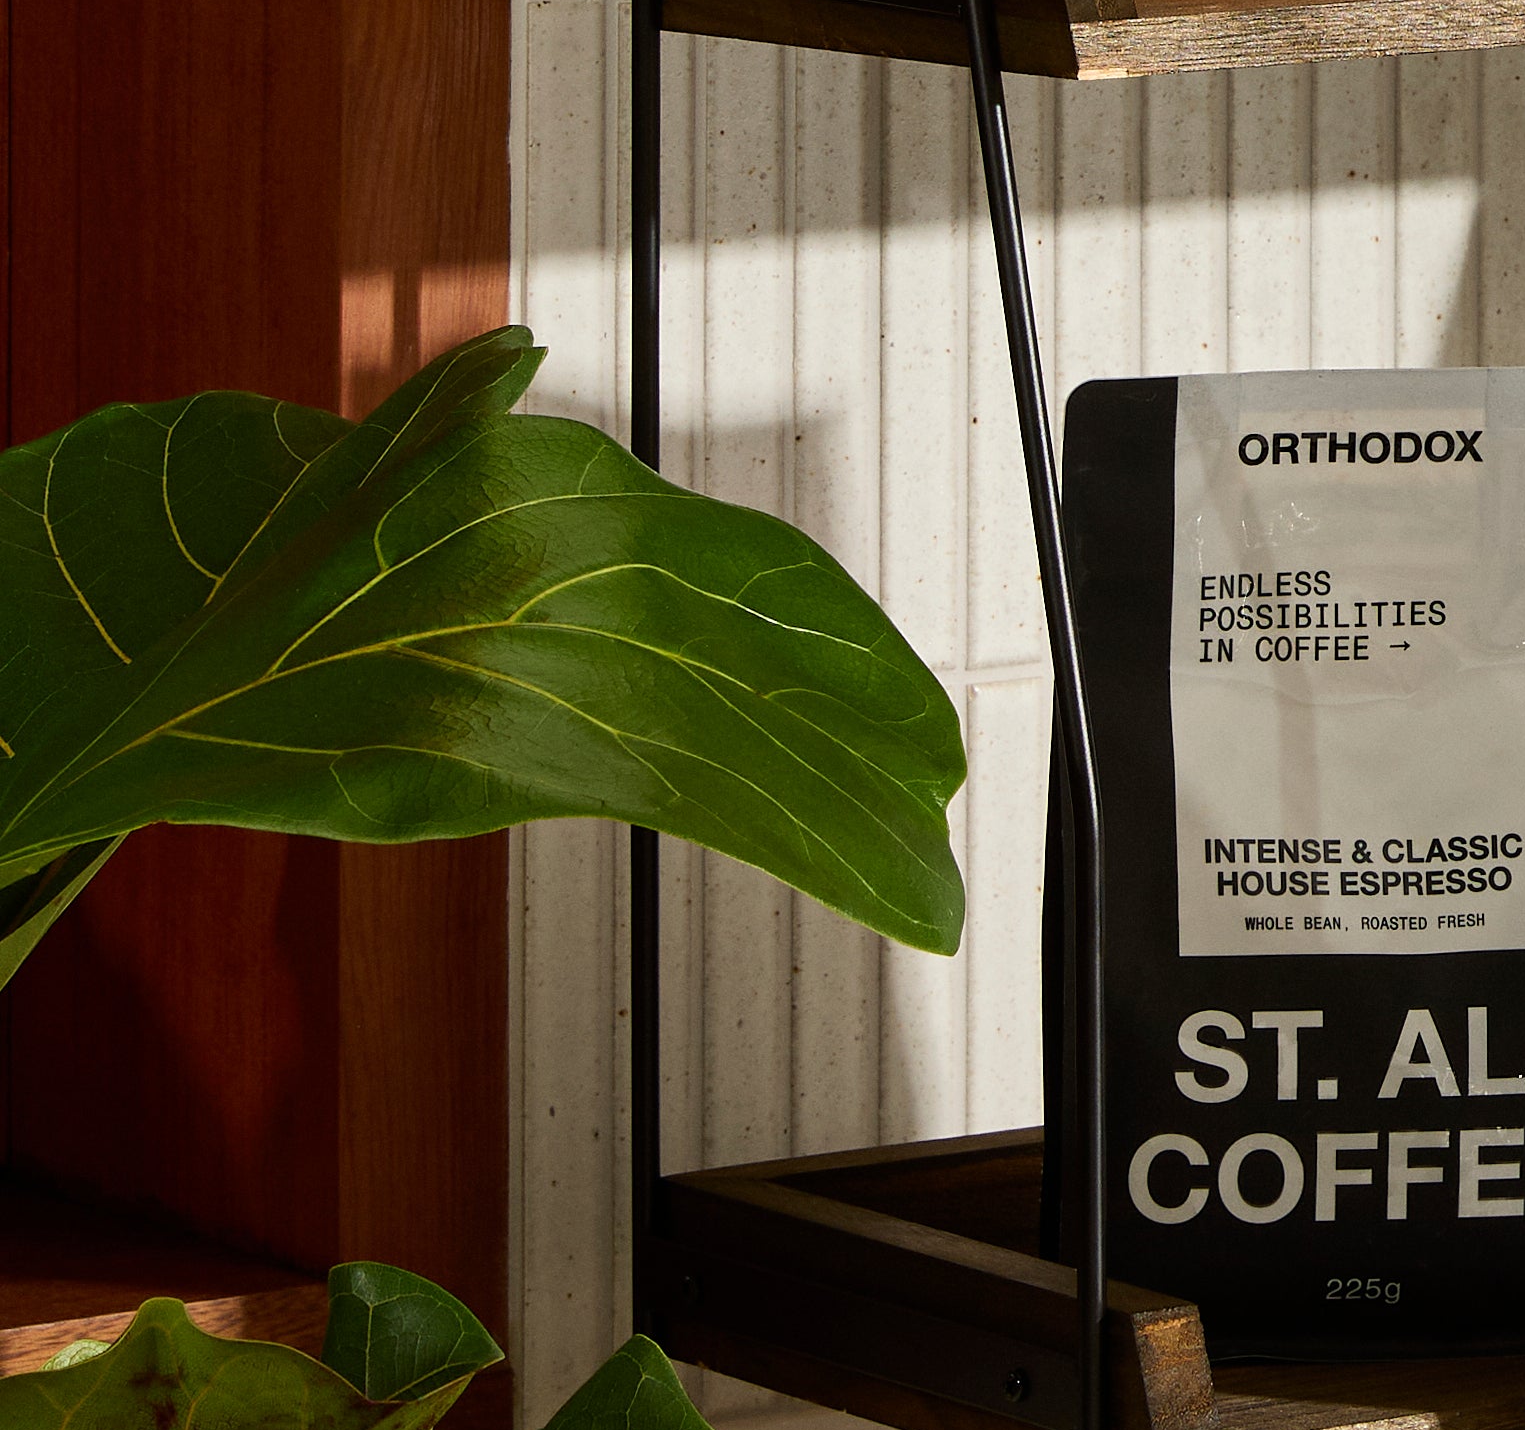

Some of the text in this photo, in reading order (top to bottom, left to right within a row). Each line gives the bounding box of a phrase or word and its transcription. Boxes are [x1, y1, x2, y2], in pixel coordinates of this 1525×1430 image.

[1239, 431, 1483, 466] ORTHODOX
[1200, 570, 1331, 600] ENDLESS
[1199, 600, 1447, 631] POSSIBILITIES
[1200, 636, 1369, 662] IN COFFEE
[1205, 833, 1523, 864] INTENSE & CLASSIC
[1217, 866, 1512, 896] HOUSE ESPRESSO
[1245, 913, 1485, 932] WHOLE BEAN, ROASTED FRESH
[1175, 1010, 1337, 1103] ST.
[1326, 1278, 1400, 1303] 225g
